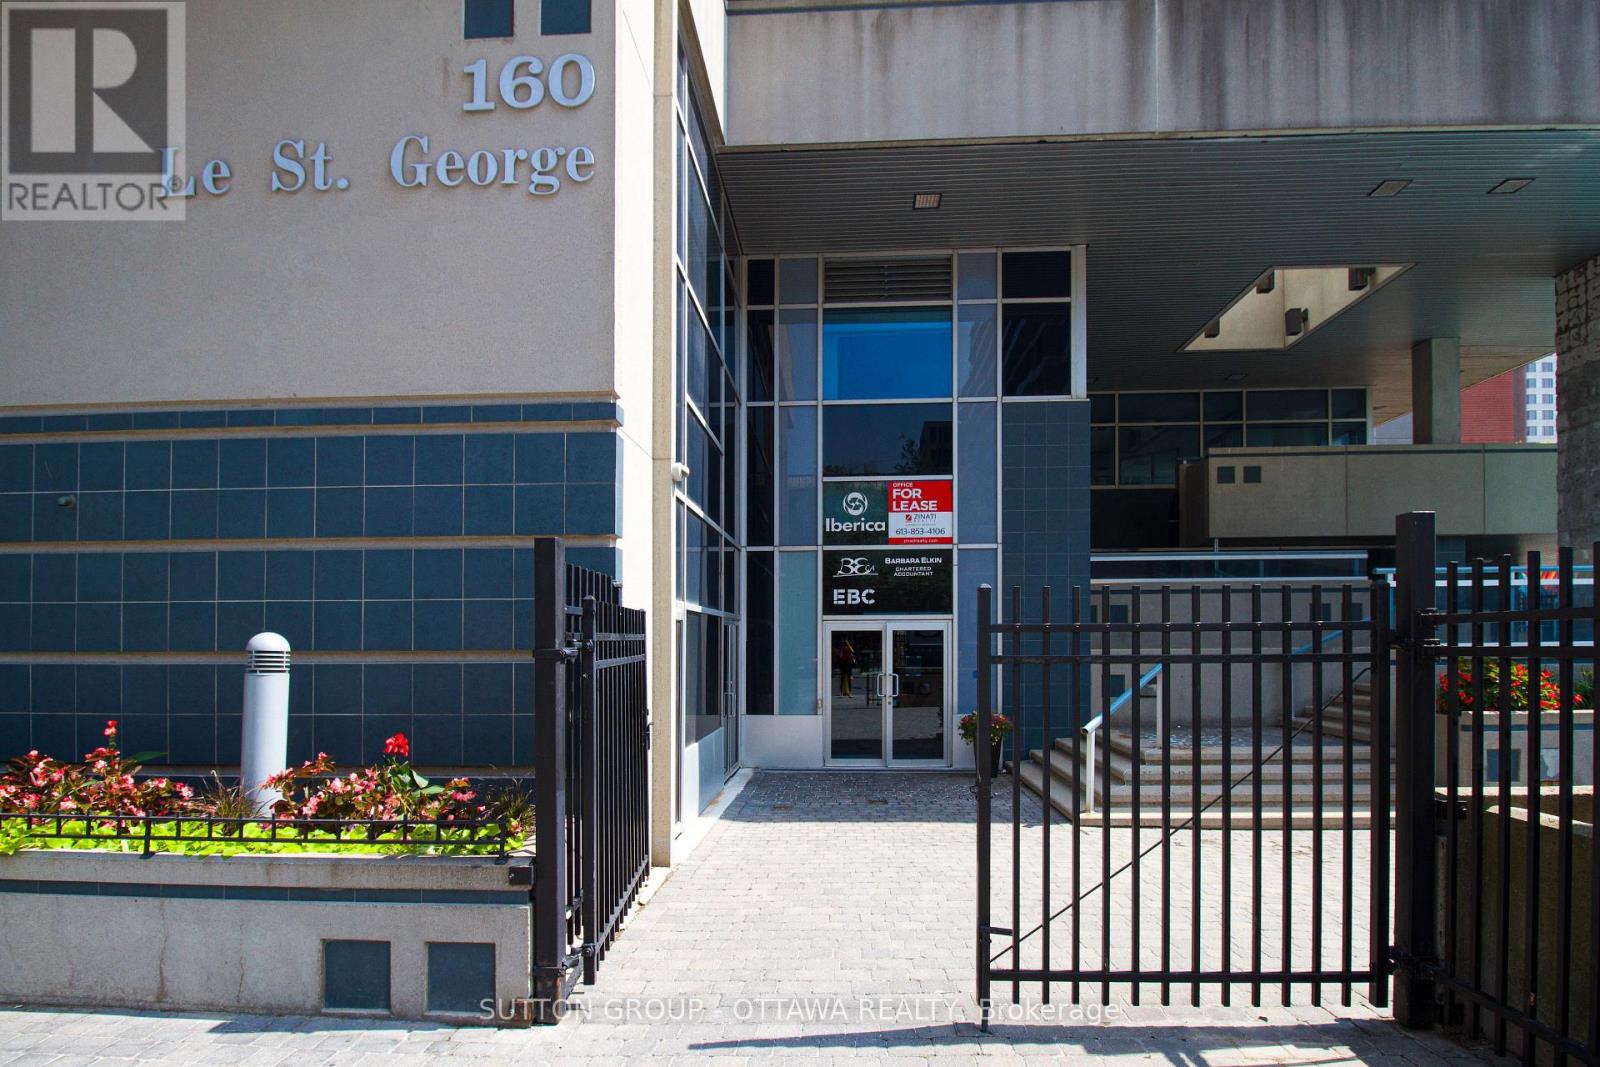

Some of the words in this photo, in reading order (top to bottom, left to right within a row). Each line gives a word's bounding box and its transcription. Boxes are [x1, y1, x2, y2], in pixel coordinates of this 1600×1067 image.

[463, 53, 597, 112] 160
[157, 146, 232, 198] Le
[271, 139, 350, 192] St.
[389, 135, 596, 196] George
[892, 488, 922, 499] FOR
[892, 500, 938, 511] LEASE
[825, 517, 886, 532] Iberica
[895, 527, 946, 536] 613-853-4106
[884, 557, 920, 565] BARBARA
[920, 556, 942, 564] ELKIN
[833, 588, 875, 605] EBC
